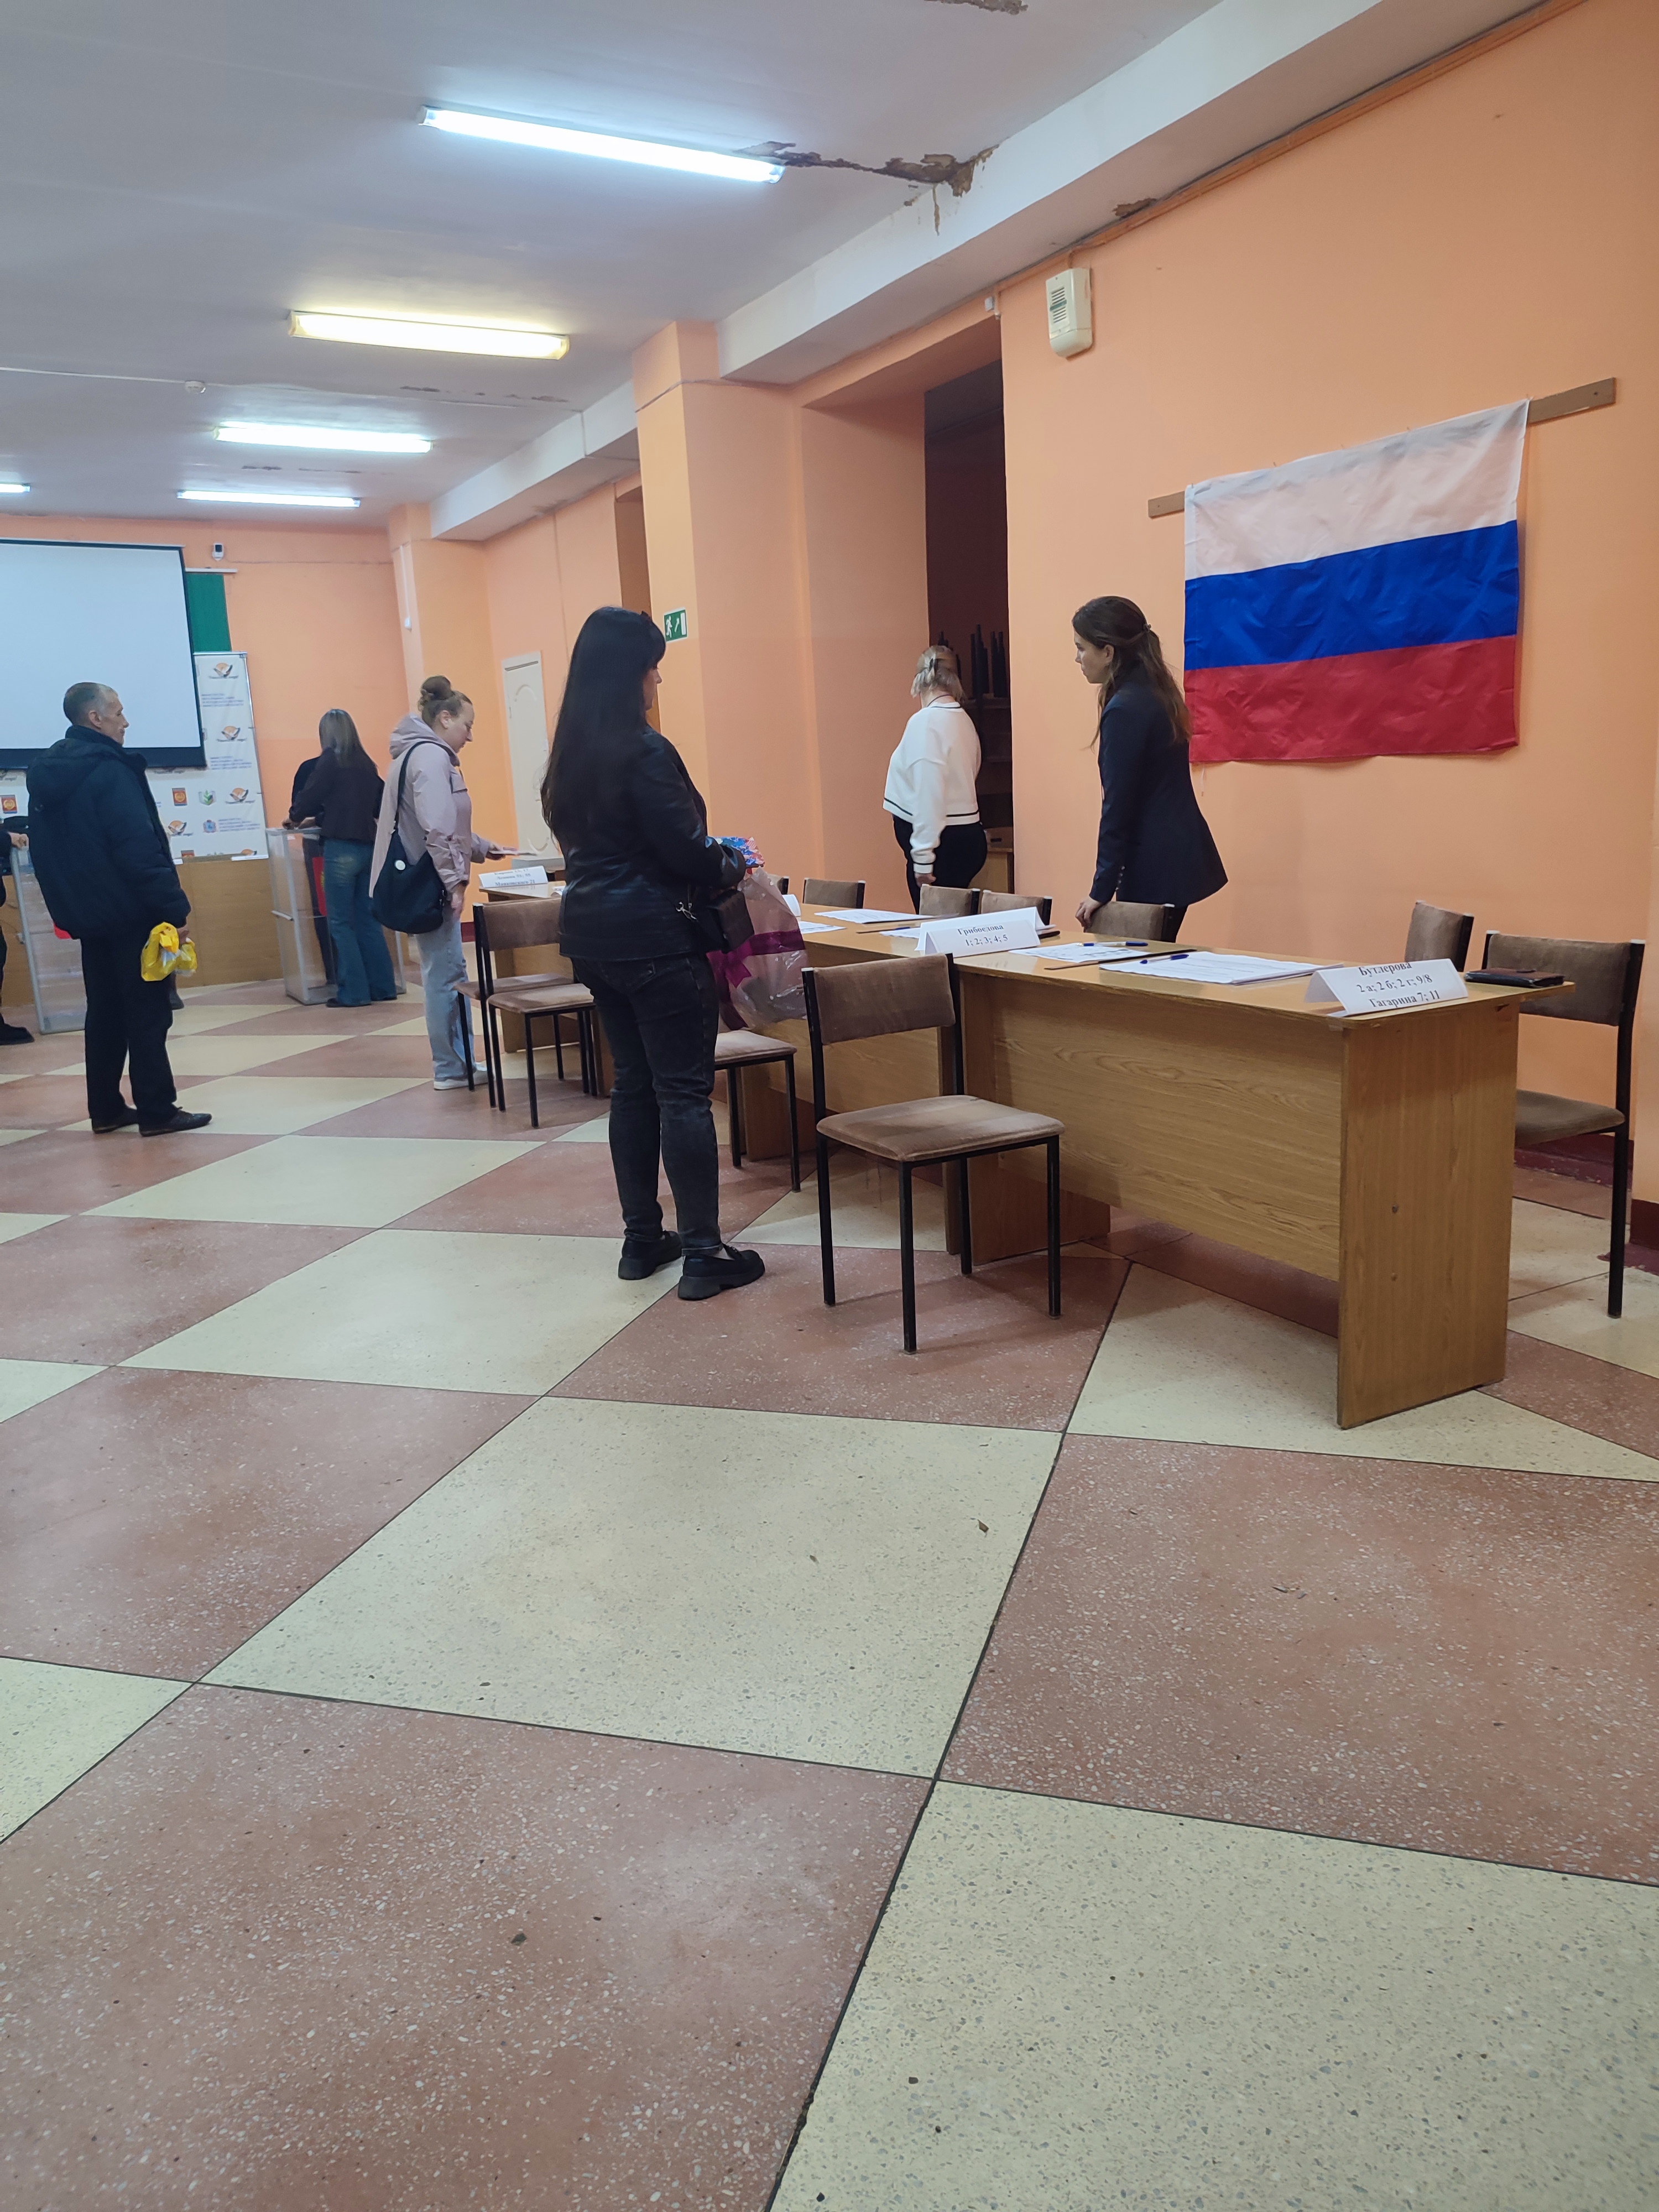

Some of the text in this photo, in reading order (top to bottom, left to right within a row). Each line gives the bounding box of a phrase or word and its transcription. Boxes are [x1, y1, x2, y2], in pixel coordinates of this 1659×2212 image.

[957, 925, 1004, 936] Грибоедова
[1358, 962, 1412, 978] Бутлерова
[1416, 974, 1433, 984] 9/8
[1368, 989, 1441, 1008] Гагарина 7; 11
